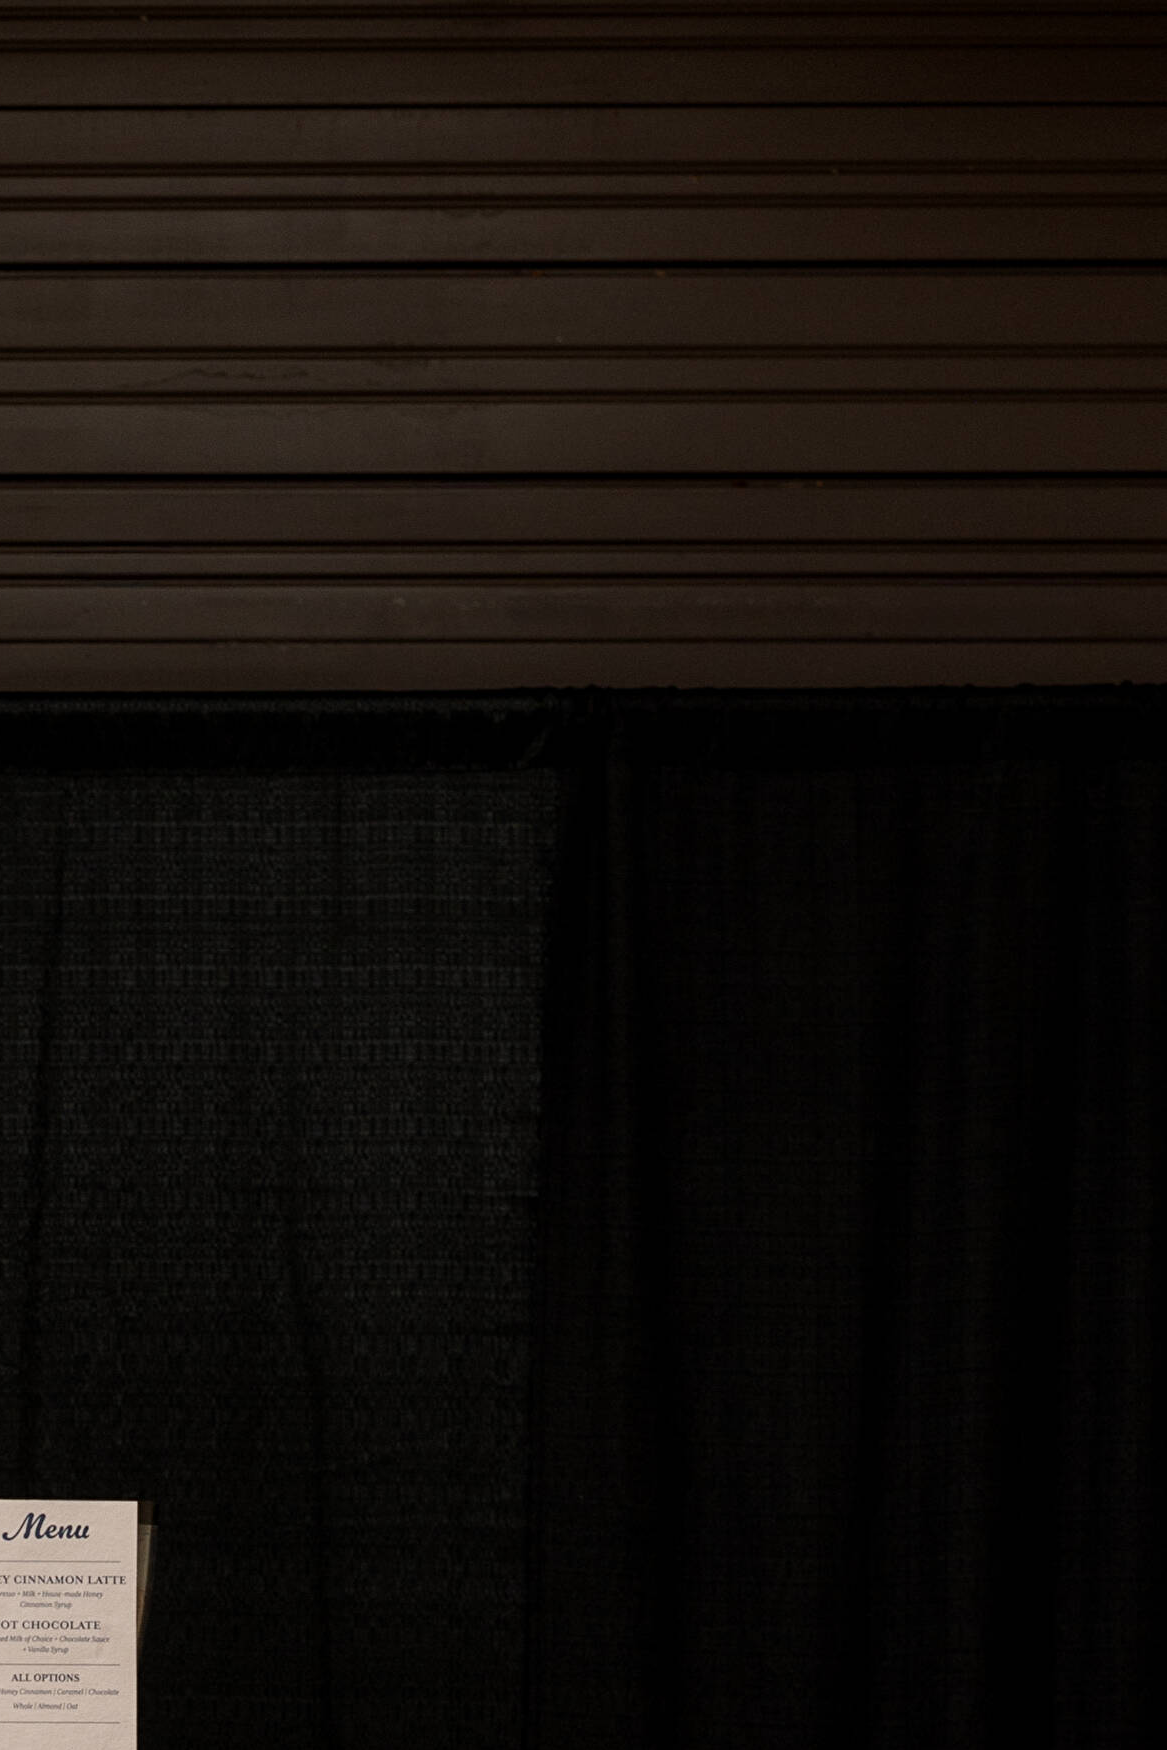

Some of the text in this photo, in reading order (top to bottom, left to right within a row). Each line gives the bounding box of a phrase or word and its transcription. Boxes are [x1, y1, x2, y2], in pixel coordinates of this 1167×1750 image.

[2, 1512, 90, 1541] Menu
[13, 1575, 84, 1585] CINNAMON
[87, 1575, 127, 1585] LATTE
[21, 1620, 102, 1630] CHOCOLATE
[11, 1673, 80, 1682] ALL OPTIONS
[12, 1702, 33, 1710] Whole
[37, 1702, 62, 1710] Almond
